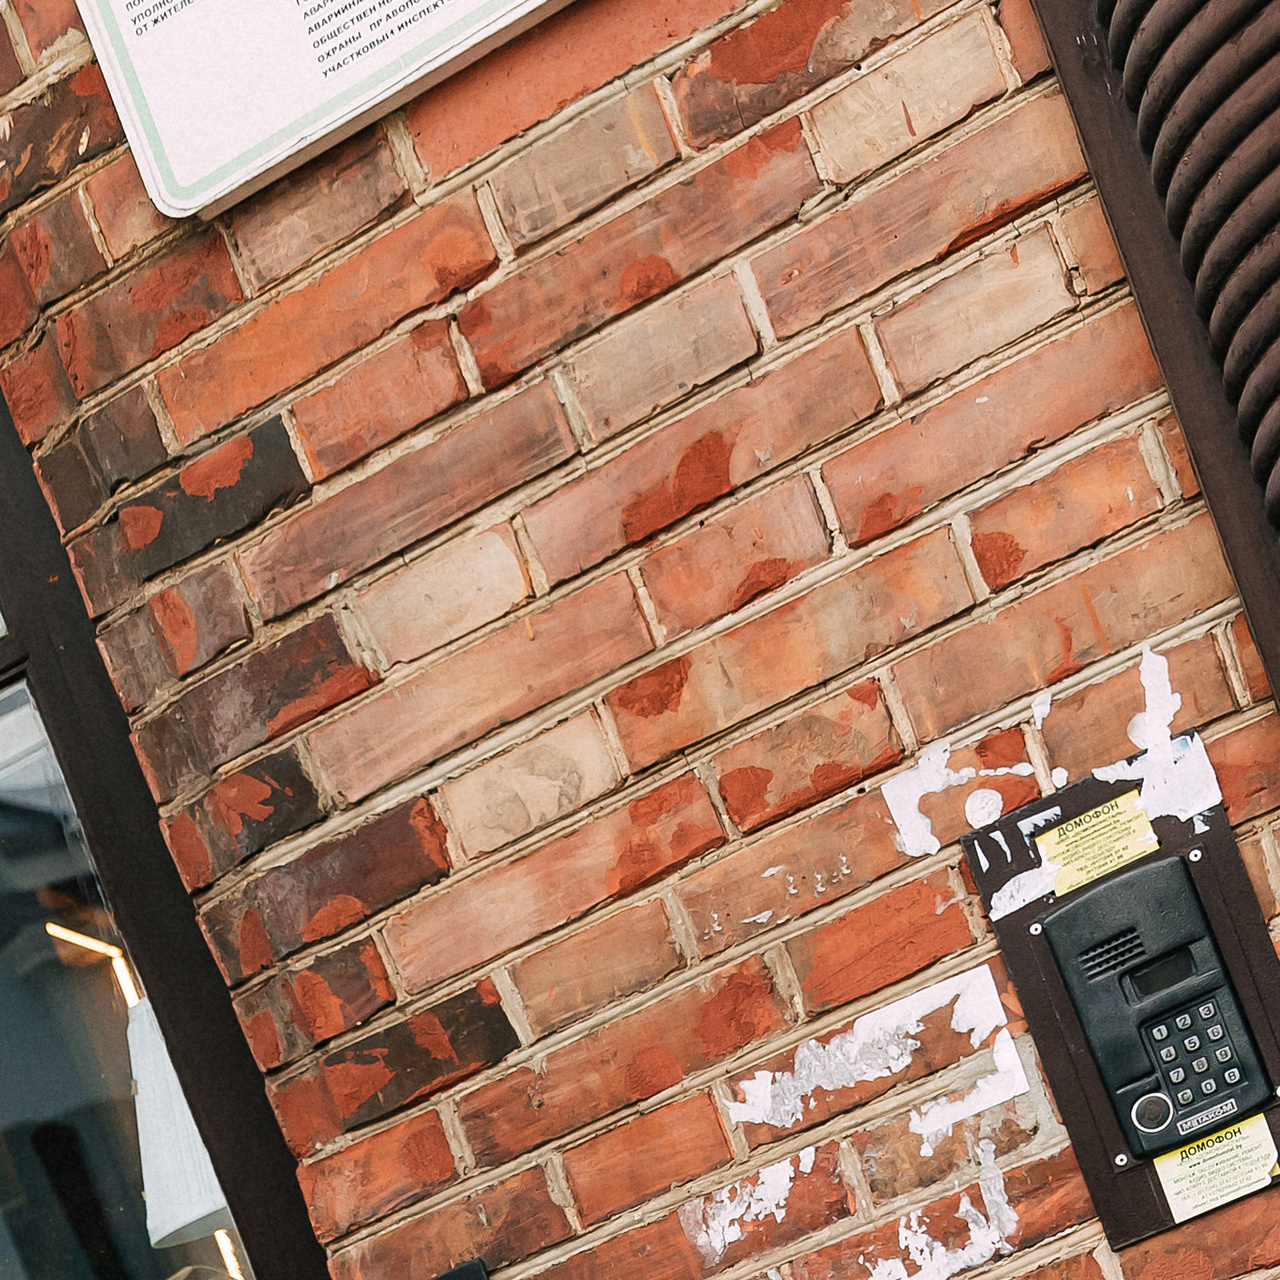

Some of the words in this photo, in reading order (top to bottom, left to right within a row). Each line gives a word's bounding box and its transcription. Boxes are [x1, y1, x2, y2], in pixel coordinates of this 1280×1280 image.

[135, 23, 149, 37] ОТ
[317, 31, 362, 63] ОХРАНЫ
[1057, 800, 1119, 839] ДОМОФОН
[1179, 1126, 1242, 1162] ДОМОФОН
